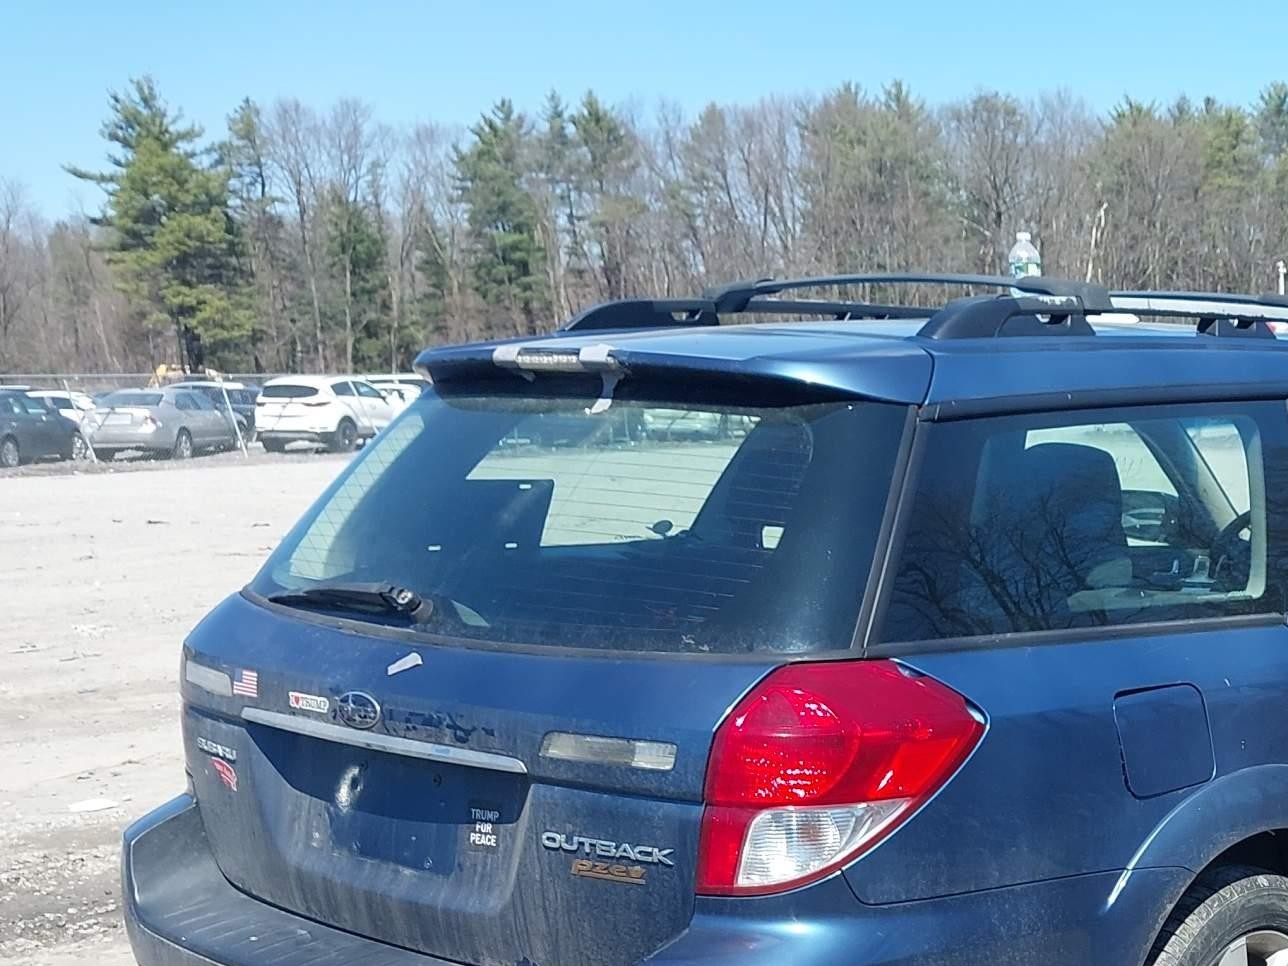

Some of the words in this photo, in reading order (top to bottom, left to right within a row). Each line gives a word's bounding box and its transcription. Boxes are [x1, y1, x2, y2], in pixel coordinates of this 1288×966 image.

[470, 807, 500, 822] TRUMP
[475, 821, 493, 834] FOR
[469, 832, 497, 847] PEACE
[541, 830, 675, 867] OUTBACK
